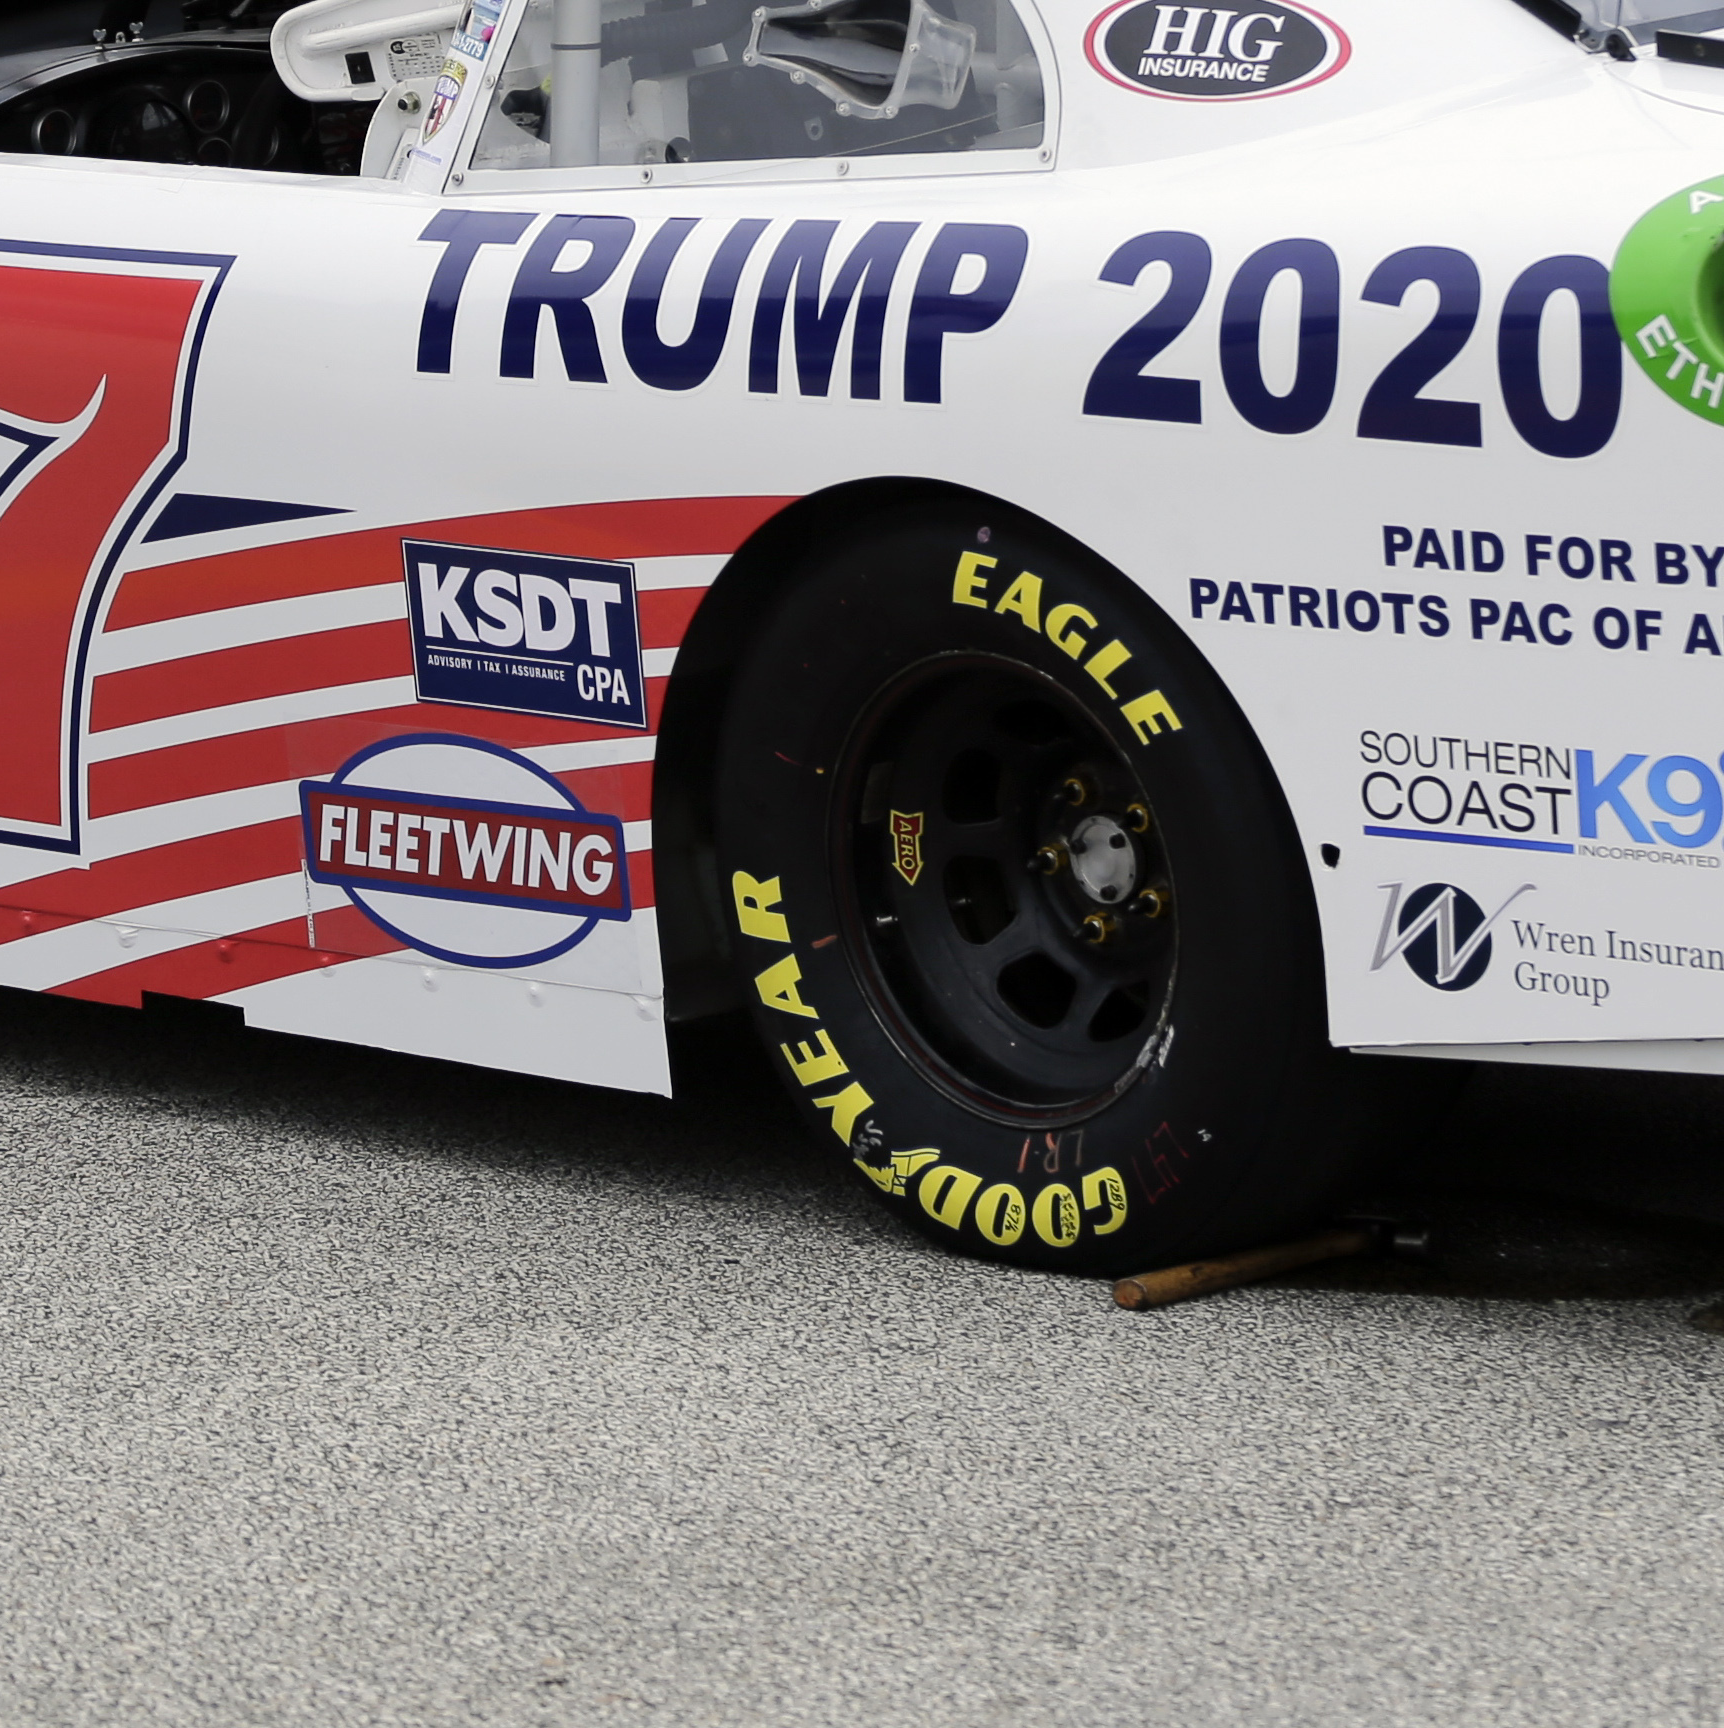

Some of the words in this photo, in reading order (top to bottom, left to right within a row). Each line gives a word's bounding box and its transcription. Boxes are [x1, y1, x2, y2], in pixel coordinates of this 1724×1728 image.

[1142, 4, 1287, 64] HIG
[1137, 56, 1270, 83] INSURANCE
[416, 208, 1030, 406] TRUMP
[1082, 229, 1625, 460] 2020
[1381, 524, 1506, 574] PAID
[1523, 533, 1637, 584] FOR
[416, 561, 622, 659] KSDT
[1188, 577, 1451, 639] PATRIOTS
[1469, 597, 1573, 647] PAC
[1592, 607, 1664, 654] OF
[427, 653, 473, 671] ADVISORY
[483, 660, 502, 675] TAX
[511, 664, 566, 683] ASSURANCE
[952, 550, 1183, 746] EAGLE
[576, 664, 631, 706] CPA
[1359, 729, 1572, 780] SOUTHERN
[1361, 770, 1572, 835] COAST
[1575, 748, 1724, 849] K9
[318, 802, 614, 897] FLEETWING
[899, 819, 916, 870] AERO
[1577, 843, 1722, 869] INCORPORATED
[1511, 918, 1596, 958] Wren
[1513, 961, 1611, 1007] Group
[732, 868, 1128, 1248] GOODYEAR
